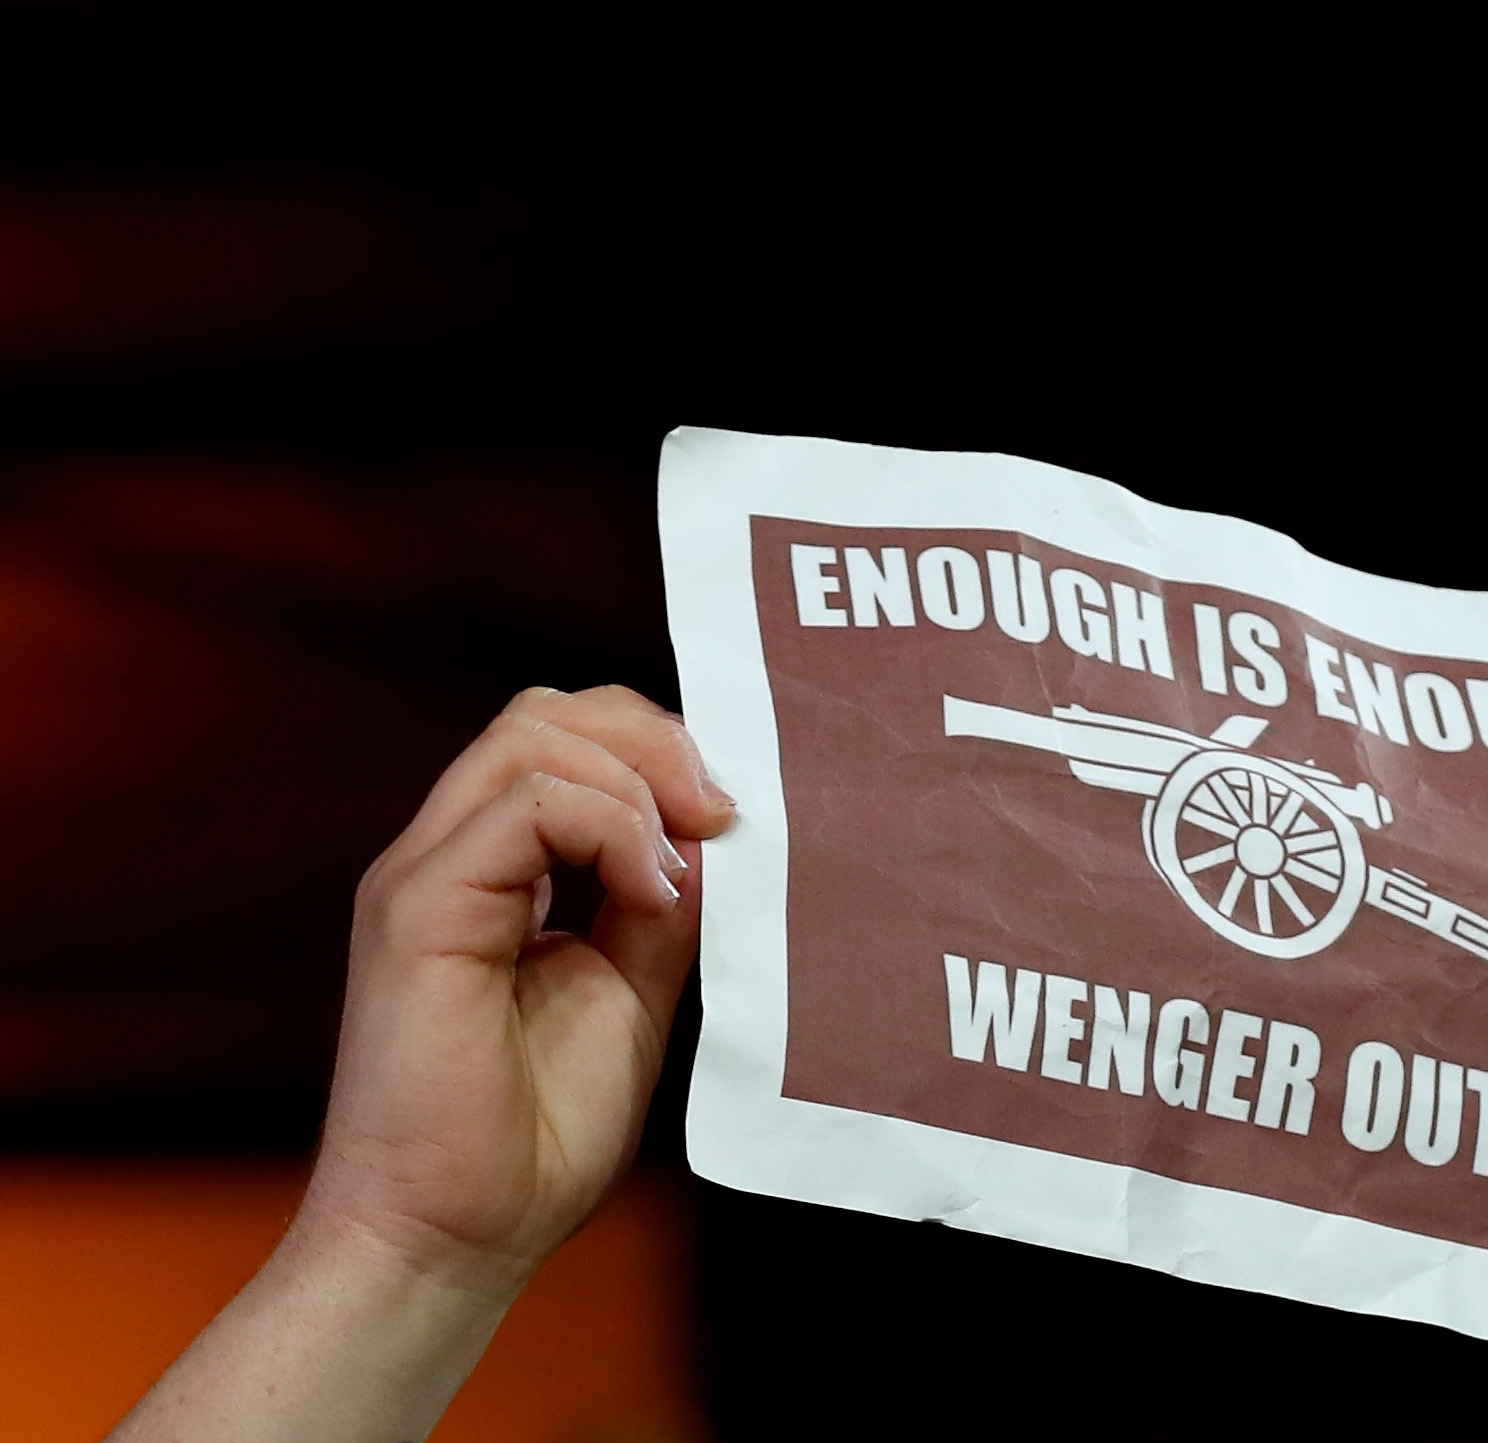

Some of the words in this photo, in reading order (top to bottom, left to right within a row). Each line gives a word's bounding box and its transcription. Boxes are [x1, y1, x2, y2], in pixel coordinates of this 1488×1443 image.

[790, 544, 1174, 681] ENOUGH
[1193, 603, 1289, 708] IS
[943, 953, 1321, 1136] WENGER
